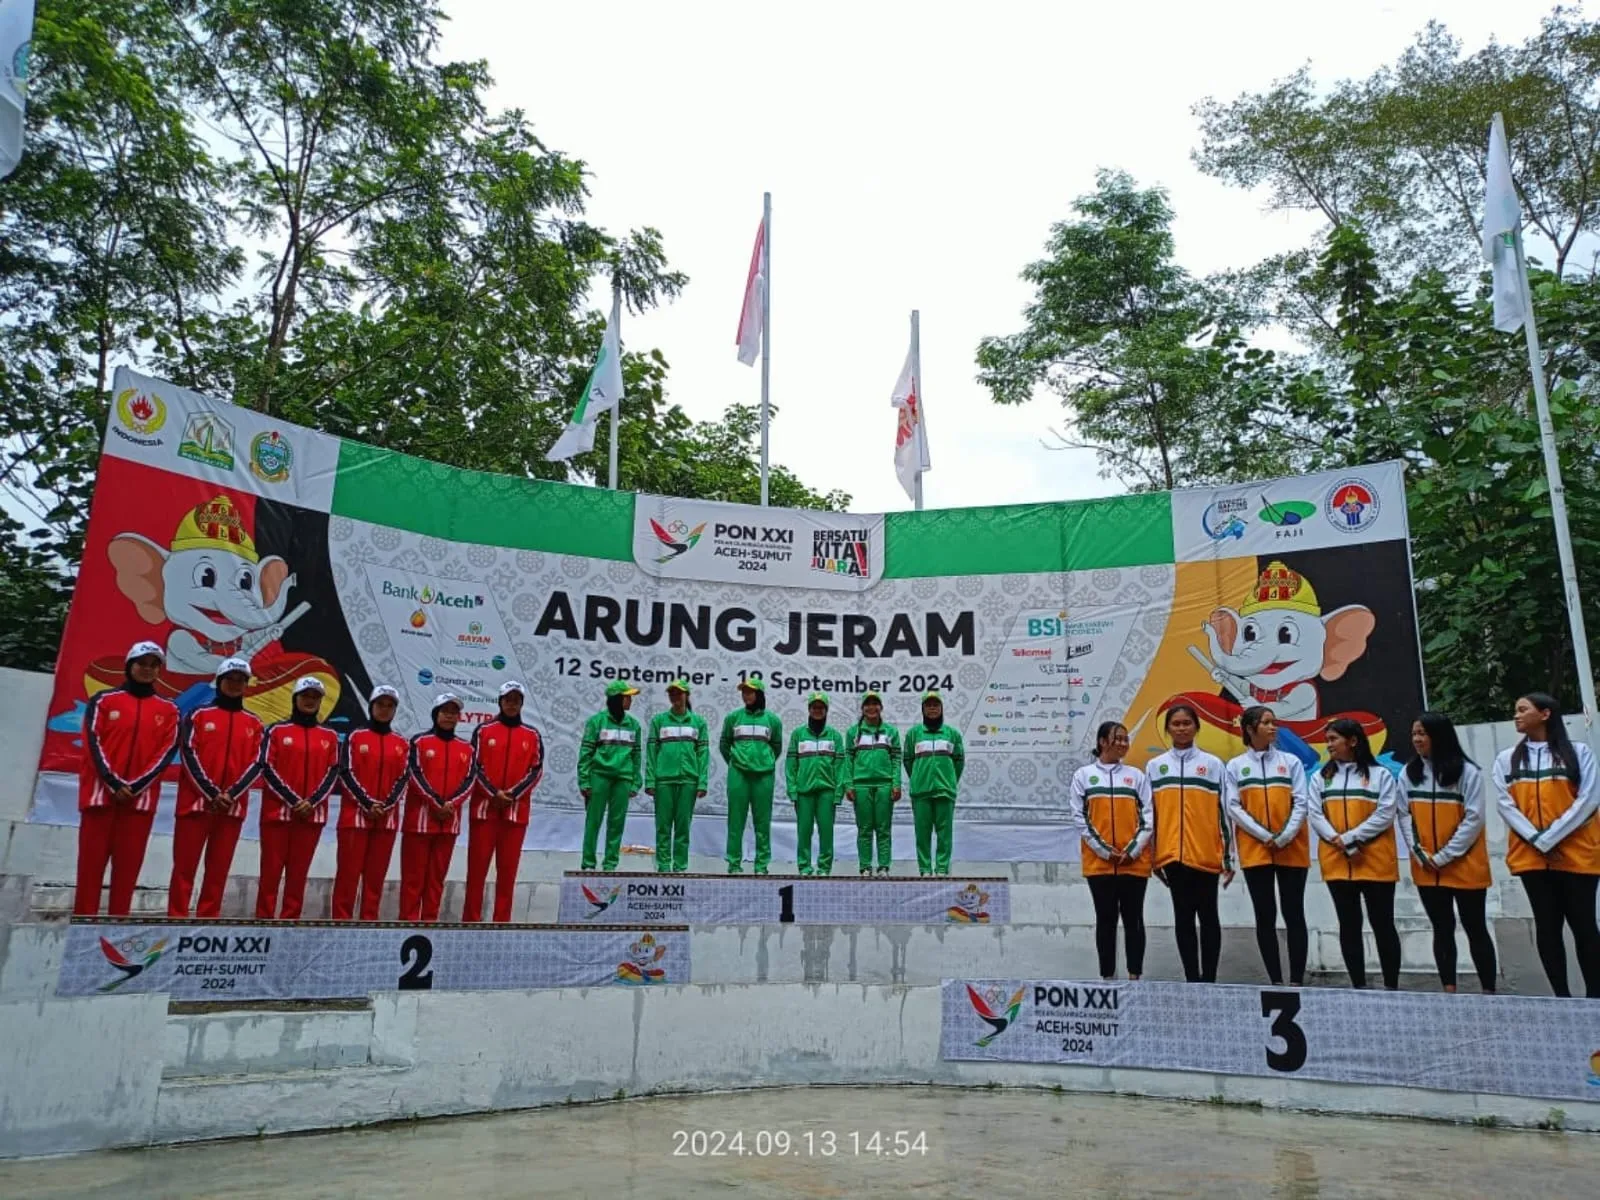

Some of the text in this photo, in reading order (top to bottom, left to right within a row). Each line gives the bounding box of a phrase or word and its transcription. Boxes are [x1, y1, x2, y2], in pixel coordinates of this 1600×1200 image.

[112, 425, 164, 447] INDONESIA
[714, 523, 794, 544] PON XXI
[813, 529, 868, 542] BERSATU
[713, 546, 793, 562] ACEH-SUMUT
[813, 541, 858, 561] KITA
[738, 560, 767, 572] 2024
[382, 580, 474, 609] Bank Aceh
[534, 590, 976, 658] ARUNG JERAM
[1028, 617, 1062, 636] BSI
[457, 634, 491, 645] BAYAN
[555, 657, 582, 676] 12
[589, 660, 715, 686] September
[770, 671, 892, 695] September
[898, 673, 954, 693] 2024
[627, 884, 685, 897] PON XXI
[778, 884, 795, 922] 1
[643, 911, 666, 920] 2024
[177, 936, 271, 953] PON XXI
[173, 963, 266, 976] ACEH-SUMUT
[398, 934, 433, 991] 2
[200, 978, 236, 990] 2024
[1034, 986, 1119, 1010] PON XXI
[1035, 1019, 1119, 1037] ACEH-SUMUT
[1260, 991, 1308, 1073] 3
[1062, 1038, 1093, 1053] 2024
